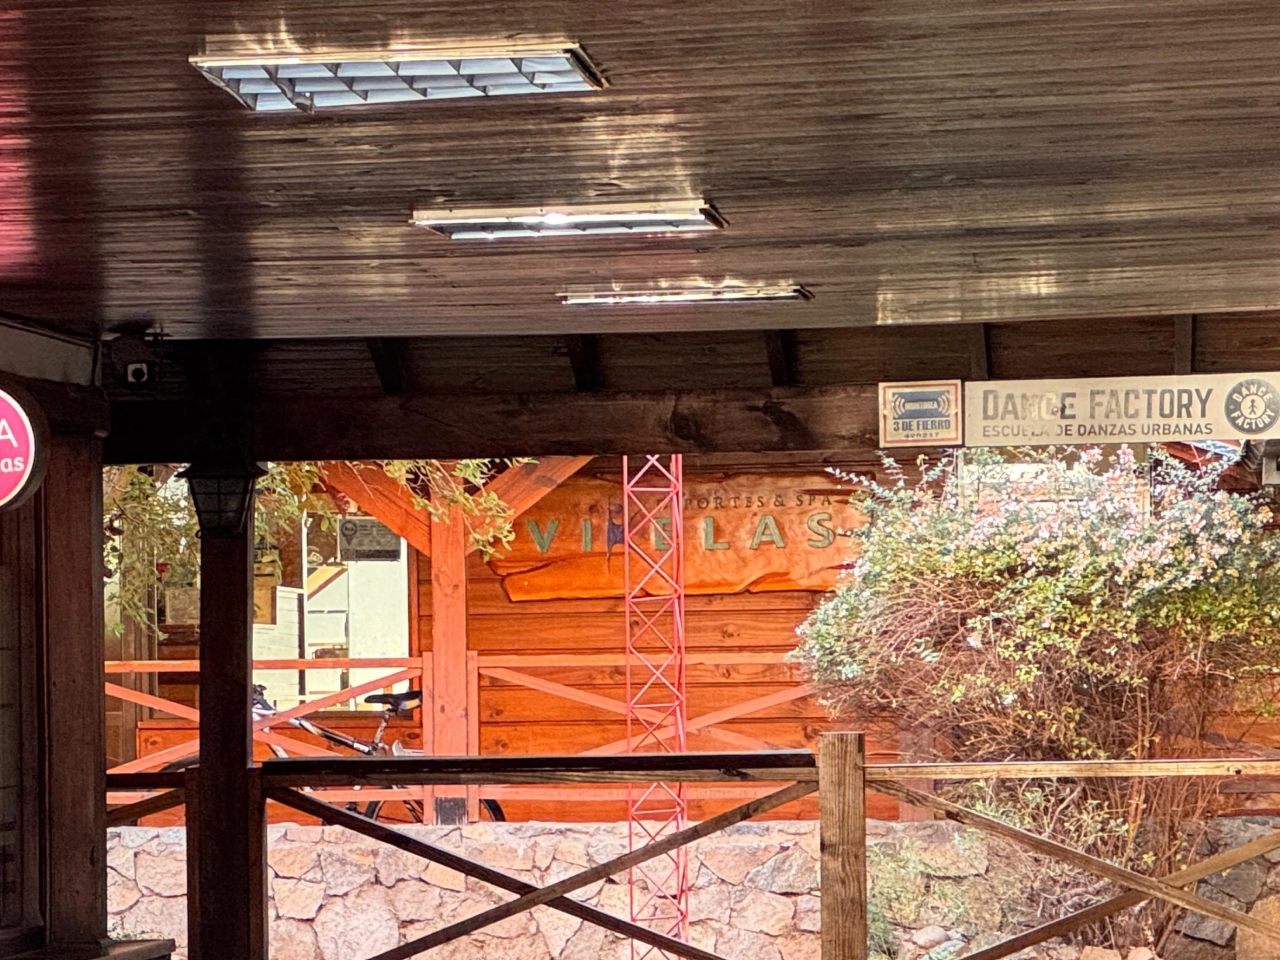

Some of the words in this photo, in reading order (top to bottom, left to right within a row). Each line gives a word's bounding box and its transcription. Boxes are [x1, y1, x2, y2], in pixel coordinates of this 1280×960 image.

[1232, 384, 1274, 402] DANCE
[1089, 388, 1214, 419] FACTORY
[893, 421, 900, 432] 3
[902, 420, 914, 431] DE
[917, 419, 951, 431] FIERRO
[1230, 409, 1276, 430] FACTORY
[1078, 423, 1137, 437] DANZAS
[1141, 422, 1214, 436] URBANAS
[795, 494, 833, 507] SPA
